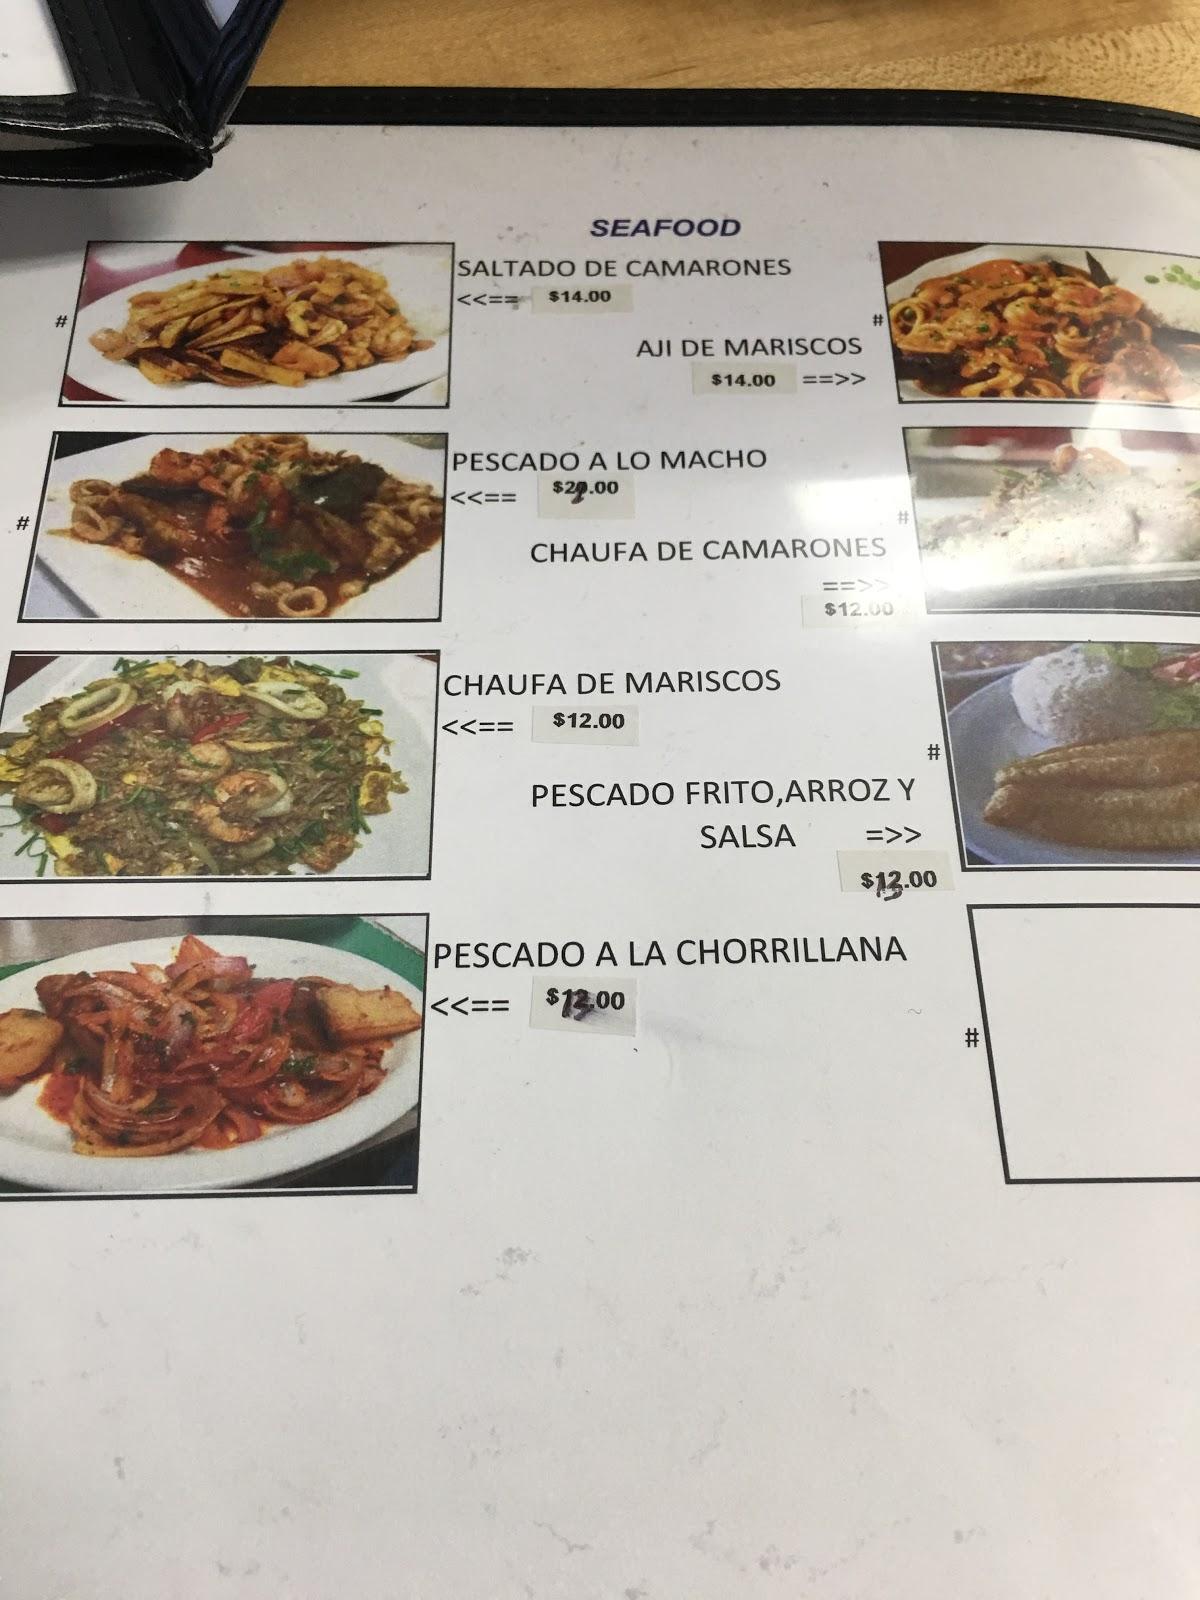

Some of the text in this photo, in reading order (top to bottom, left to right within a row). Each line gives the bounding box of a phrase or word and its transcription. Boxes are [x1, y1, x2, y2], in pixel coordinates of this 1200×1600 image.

[590, 218, 741, 238] SEAFOOD
[457, 258, 792, 278] SALTADO DE CAMARONES
[548, 289, 612, 304] $14.00
[636, 337, 863, 358] AJI DE MARISCOS
[711, 373, 777, 388] $14.00
[453, 449, 767, 472] PESCADO A LO MACHO
[531, 538, 887, 564] CHAUFA DE CAMARONES
[824, 601, 894, 617] $12.00
[443, 669, 781, 697] CHAUFA DE MARISCOS
[553, 712, 626, 730] $12.00
[532, 781, 675, 808] PESCADO
[897, 777, 916, 802] Y
[700, 824, 797, 849] SALSA
[434, 936, 908, 969] PESCADO A LA CHORRILLANA
